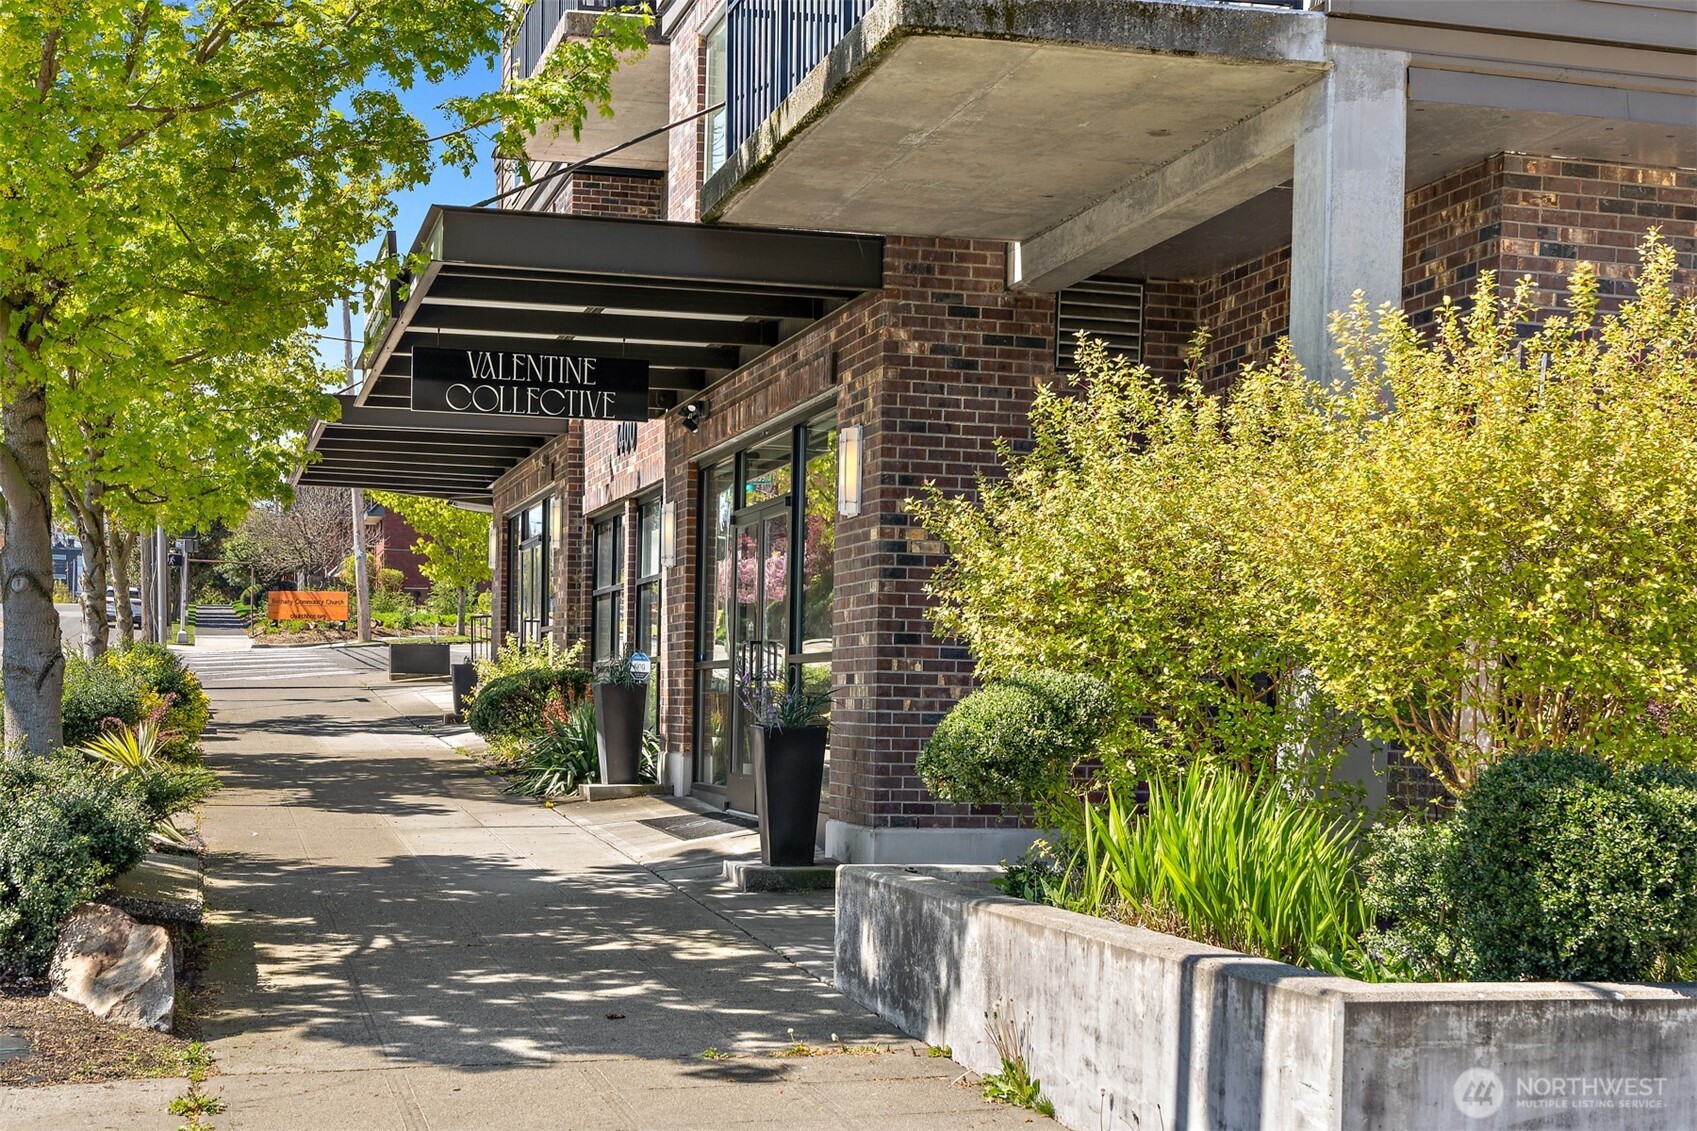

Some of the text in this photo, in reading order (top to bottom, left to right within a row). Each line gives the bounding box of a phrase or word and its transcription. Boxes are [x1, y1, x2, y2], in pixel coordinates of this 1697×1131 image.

[466, 351, 597, 385] VALENTINE
[445, 383, 616, 419] COLLECTIVE
[271, 598, 293, 606] Bethany
[294, 598, 324, 606] Community
